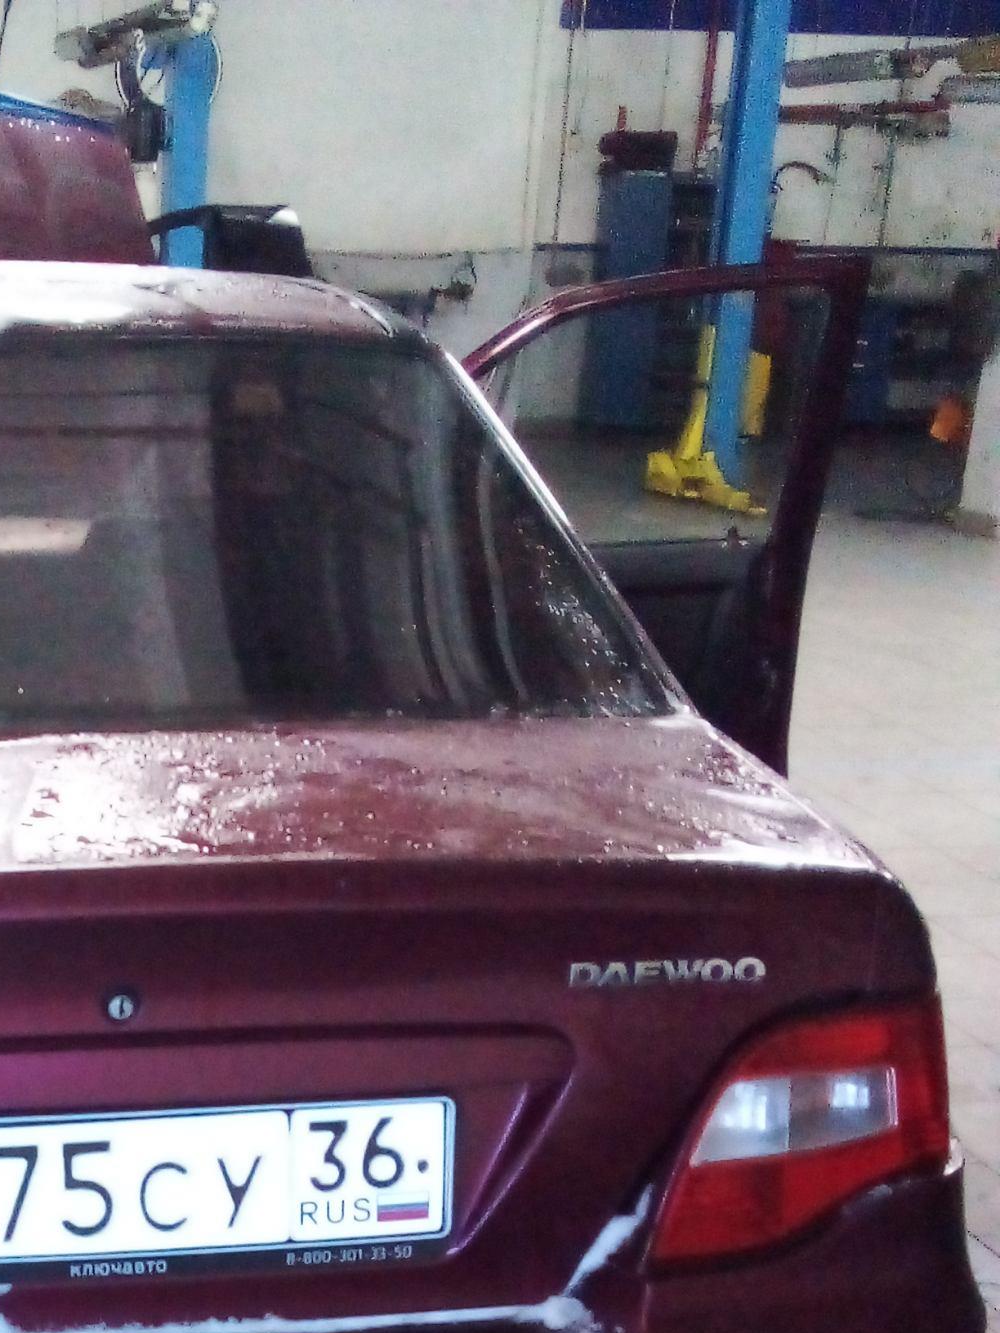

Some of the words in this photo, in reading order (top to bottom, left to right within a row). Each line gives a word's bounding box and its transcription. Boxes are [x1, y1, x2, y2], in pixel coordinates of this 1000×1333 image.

[569, 957, 767, 987] DAEWOO
[309, 1116, 405, 1192] 36
[300, 1197, 371, 1225] RUS
